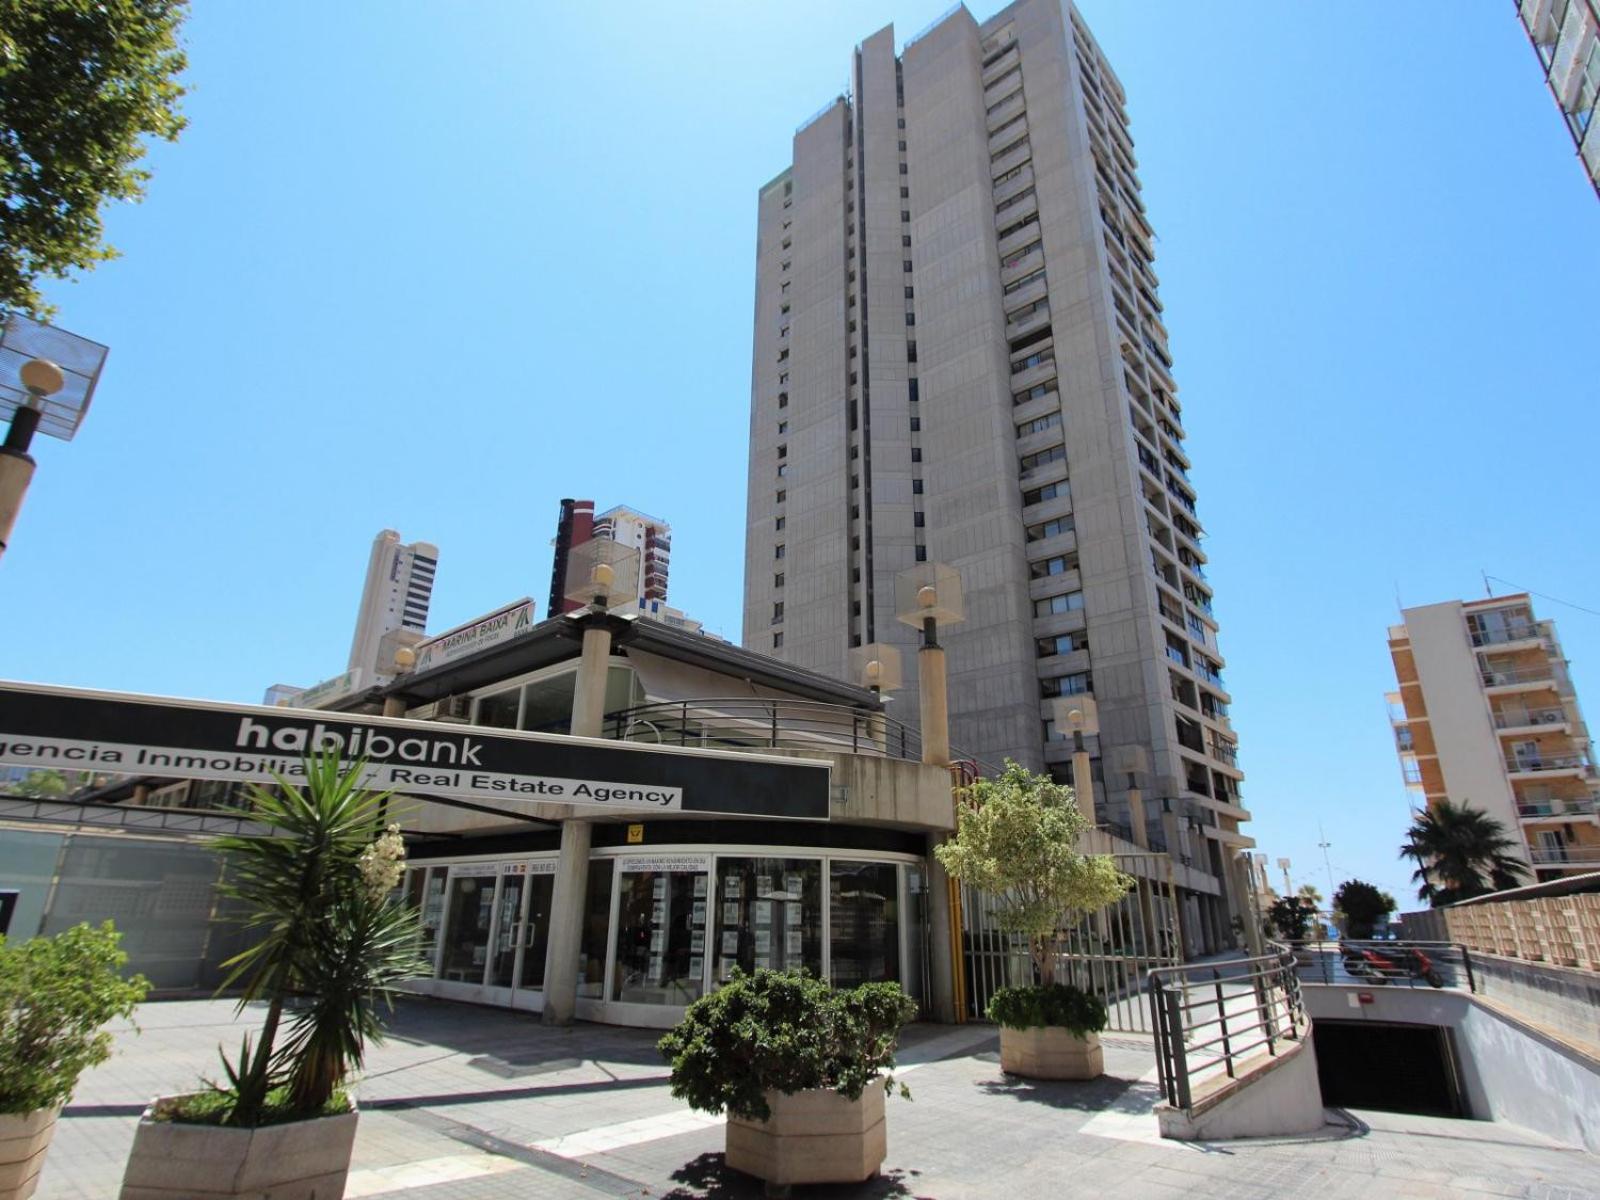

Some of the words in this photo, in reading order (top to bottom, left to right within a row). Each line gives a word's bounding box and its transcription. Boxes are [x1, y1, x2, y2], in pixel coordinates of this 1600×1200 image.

[236, 717, 483, 766] habibank
[390, 768, 460, 787] Real
[470, 775, 564, 795] Estate
[572, 783, 675, 806] Agency
